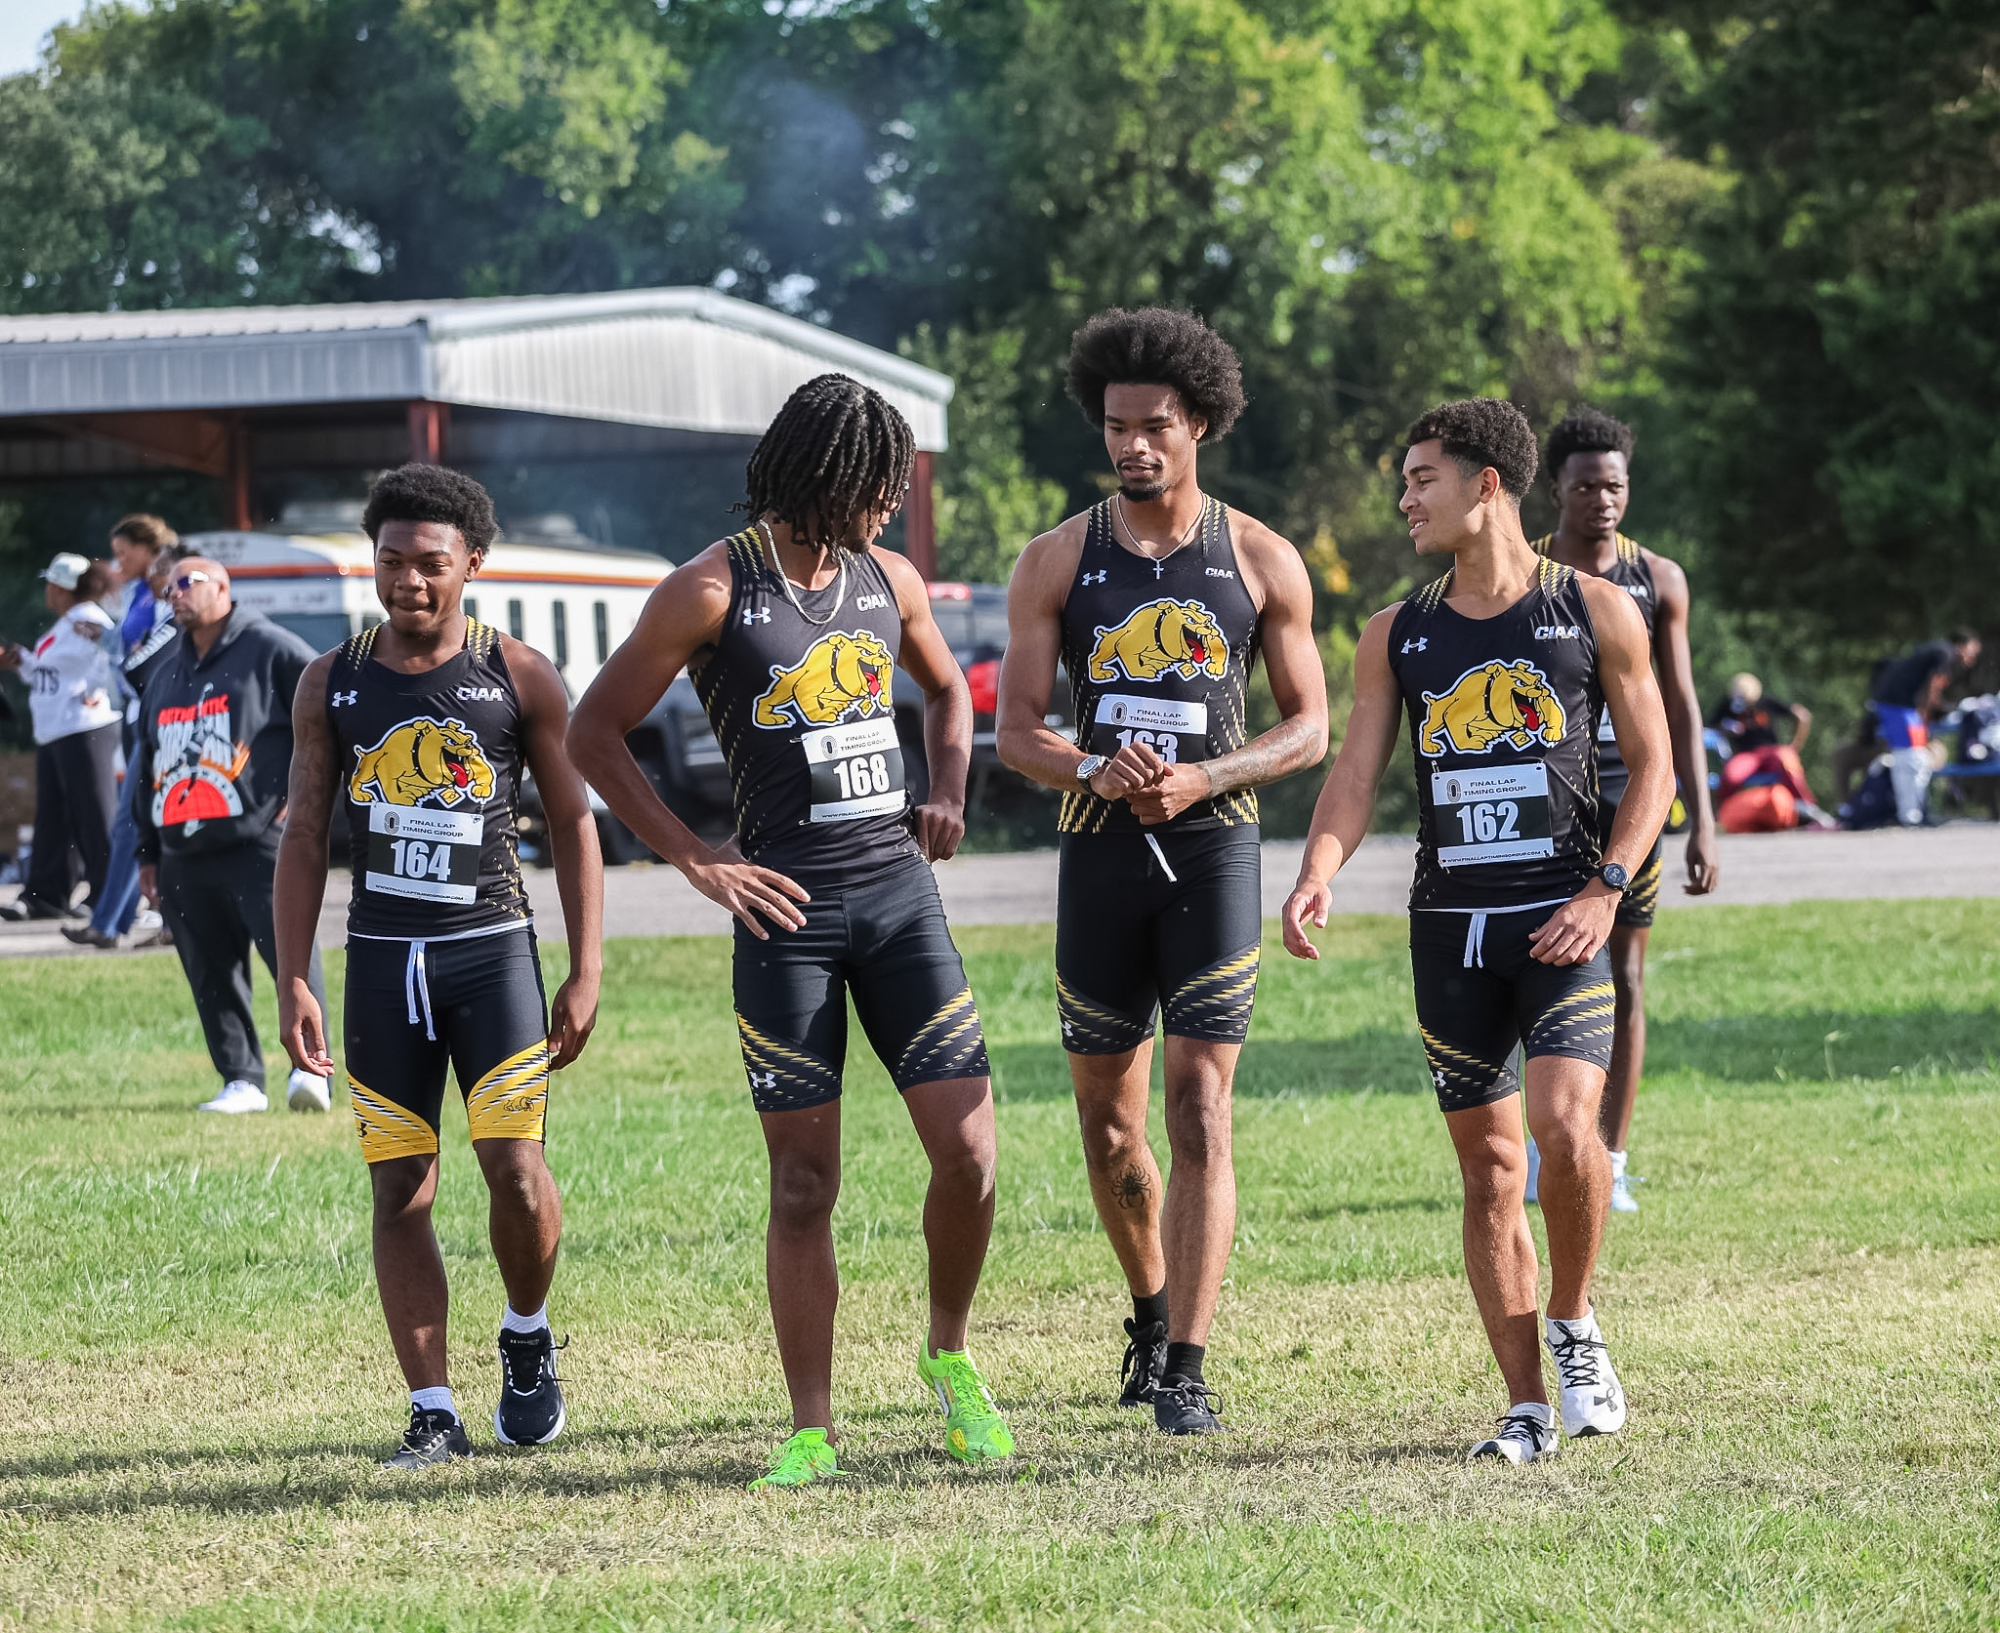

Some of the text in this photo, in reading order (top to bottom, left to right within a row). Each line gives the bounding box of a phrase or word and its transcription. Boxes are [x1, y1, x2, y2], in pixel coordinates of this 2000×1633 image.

[1205, 567, 1235, 579] CIAA
[856, 594, 889, 611] CIAA
[1535, 625, 1580, 640] CIAA
[456, 687, 504, 702] CIAA
[1137, 709, 1162, 717] FINAL
[1129, 715, 1189, 727] TIMING GROUP
[845, 734, 866, 742] FINAL
[840, 742, 867, 751] TIMING
[833, 753, 890, 799] 168
[1470, 780, 1497, 788] FINAL
[1463, 785, 1527, 796] TIMING GROUP
[409, 819, 436, 828] FINAL
[1456, 800, 1520, 843] 162
[402, 826, 433, 835] TIMING
[390, 839, 451, 881] 164
